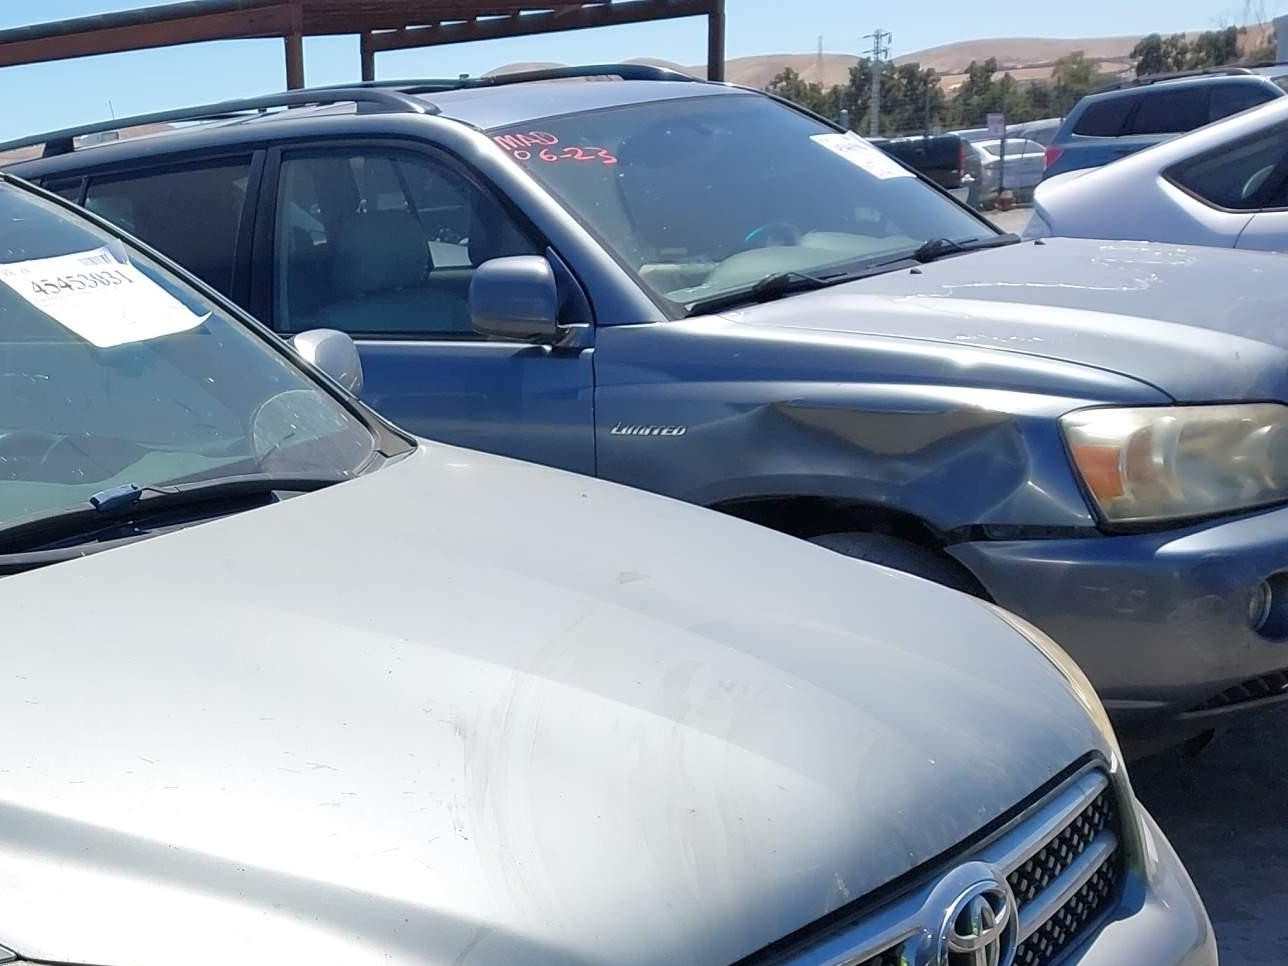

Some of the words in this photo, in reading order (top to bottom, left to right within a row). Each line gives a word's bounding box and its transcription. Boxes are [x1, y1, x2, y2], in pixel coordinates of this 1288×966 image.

[492, 130, 560, 151] MAD
[31, 269, 136, 297] 45453031
[609, 420, 687, 436] LIMITED
